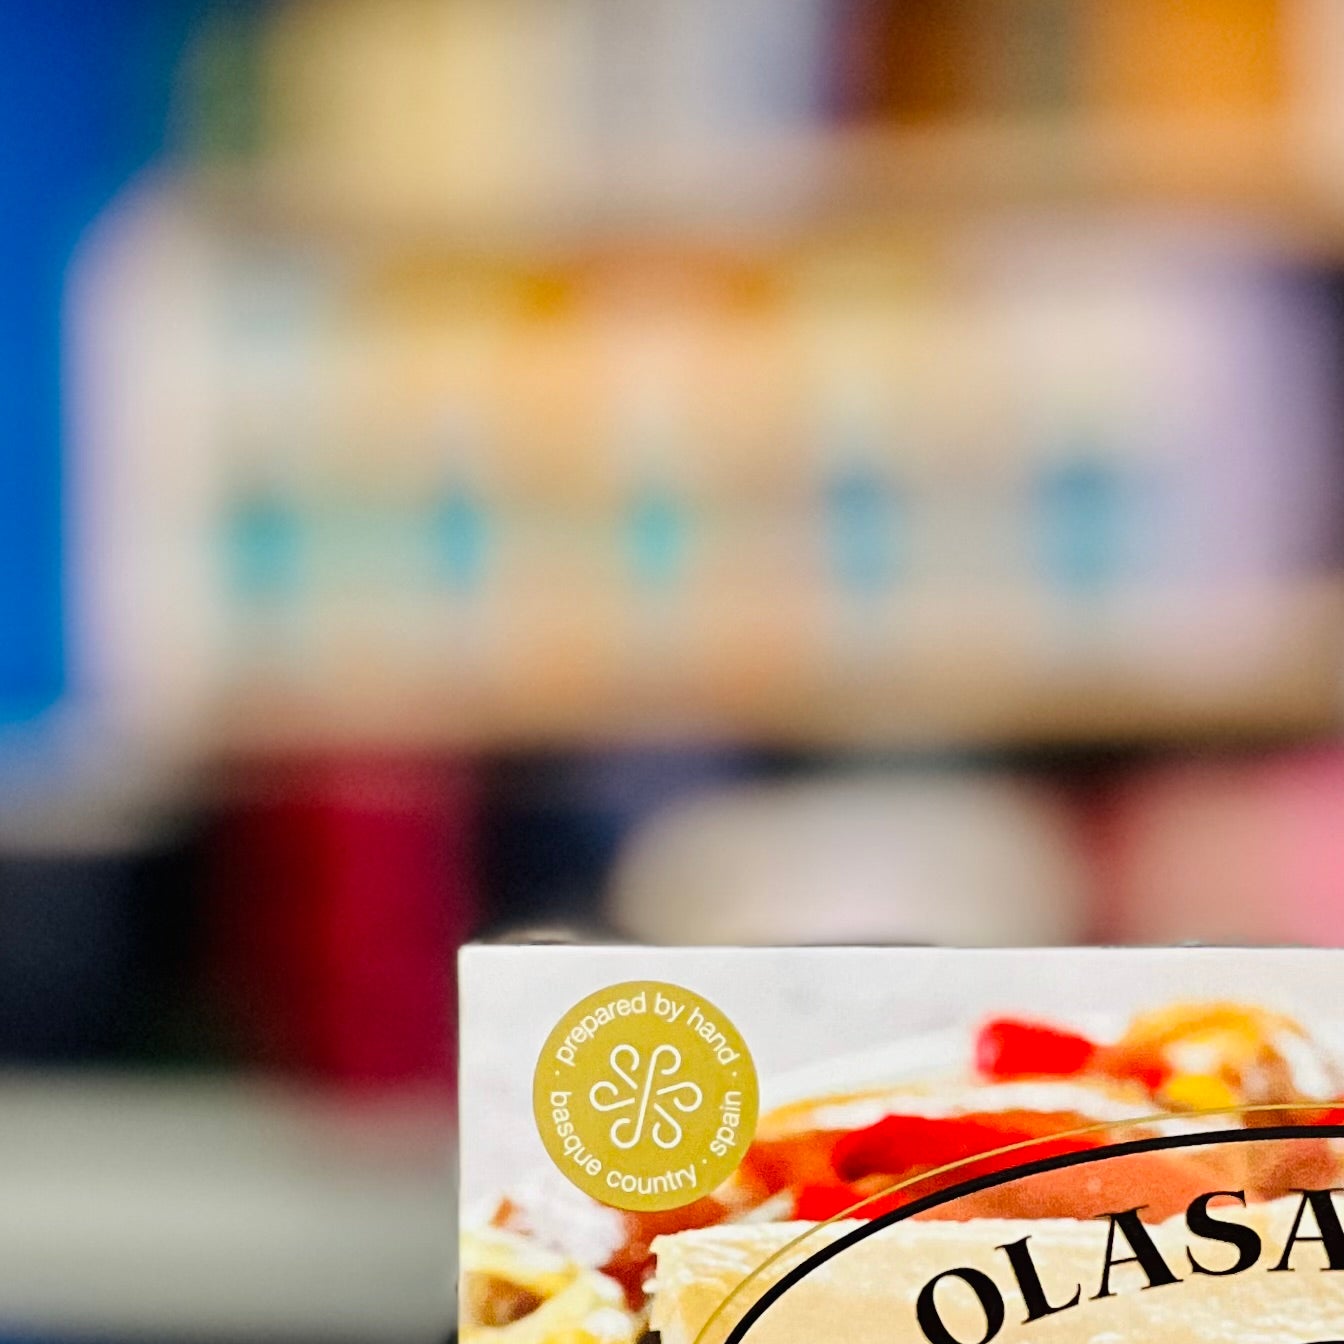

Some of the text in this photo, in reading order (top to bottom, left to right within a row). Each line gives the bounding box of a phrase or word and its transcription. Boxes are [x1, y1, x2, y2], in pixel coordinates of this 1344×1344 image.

[556, 992, 740, 1067] prepared by hand
[551, 1091, 742, 1194] basque country spain
